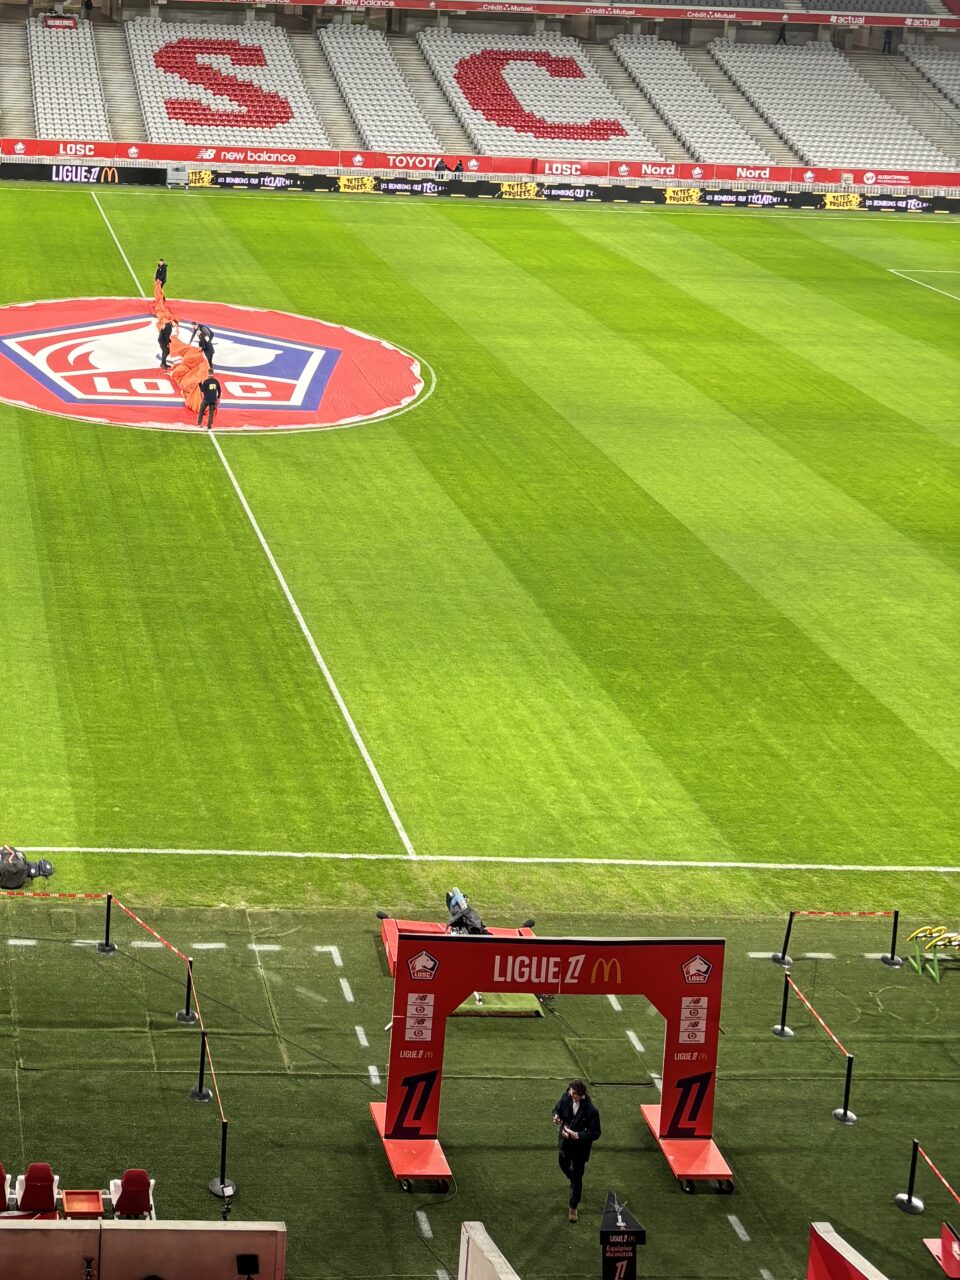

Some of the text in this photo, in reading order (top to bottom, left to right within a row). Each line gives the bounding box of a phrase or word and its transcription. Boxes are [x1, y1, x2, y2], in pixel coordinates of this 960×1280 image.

[838, 16, 865, 24] actual
[912, 18, 940, 27] actual
[59, 143, 94, 155] LOSC
[221, 152, 244, 160] new
[247, 151, 296, 162] balance
[52, 166, 89, 182] LIGUE
[545, 163, 581, 175] LOSC
[642, 164, 675, 175] Nord
[737, 167, 770, 178] Nord
[92, 376, 272, 398] LOC
[494, 956, 561, 983] LIGUE
[400, 1050, 417, 1058] LIGUE
